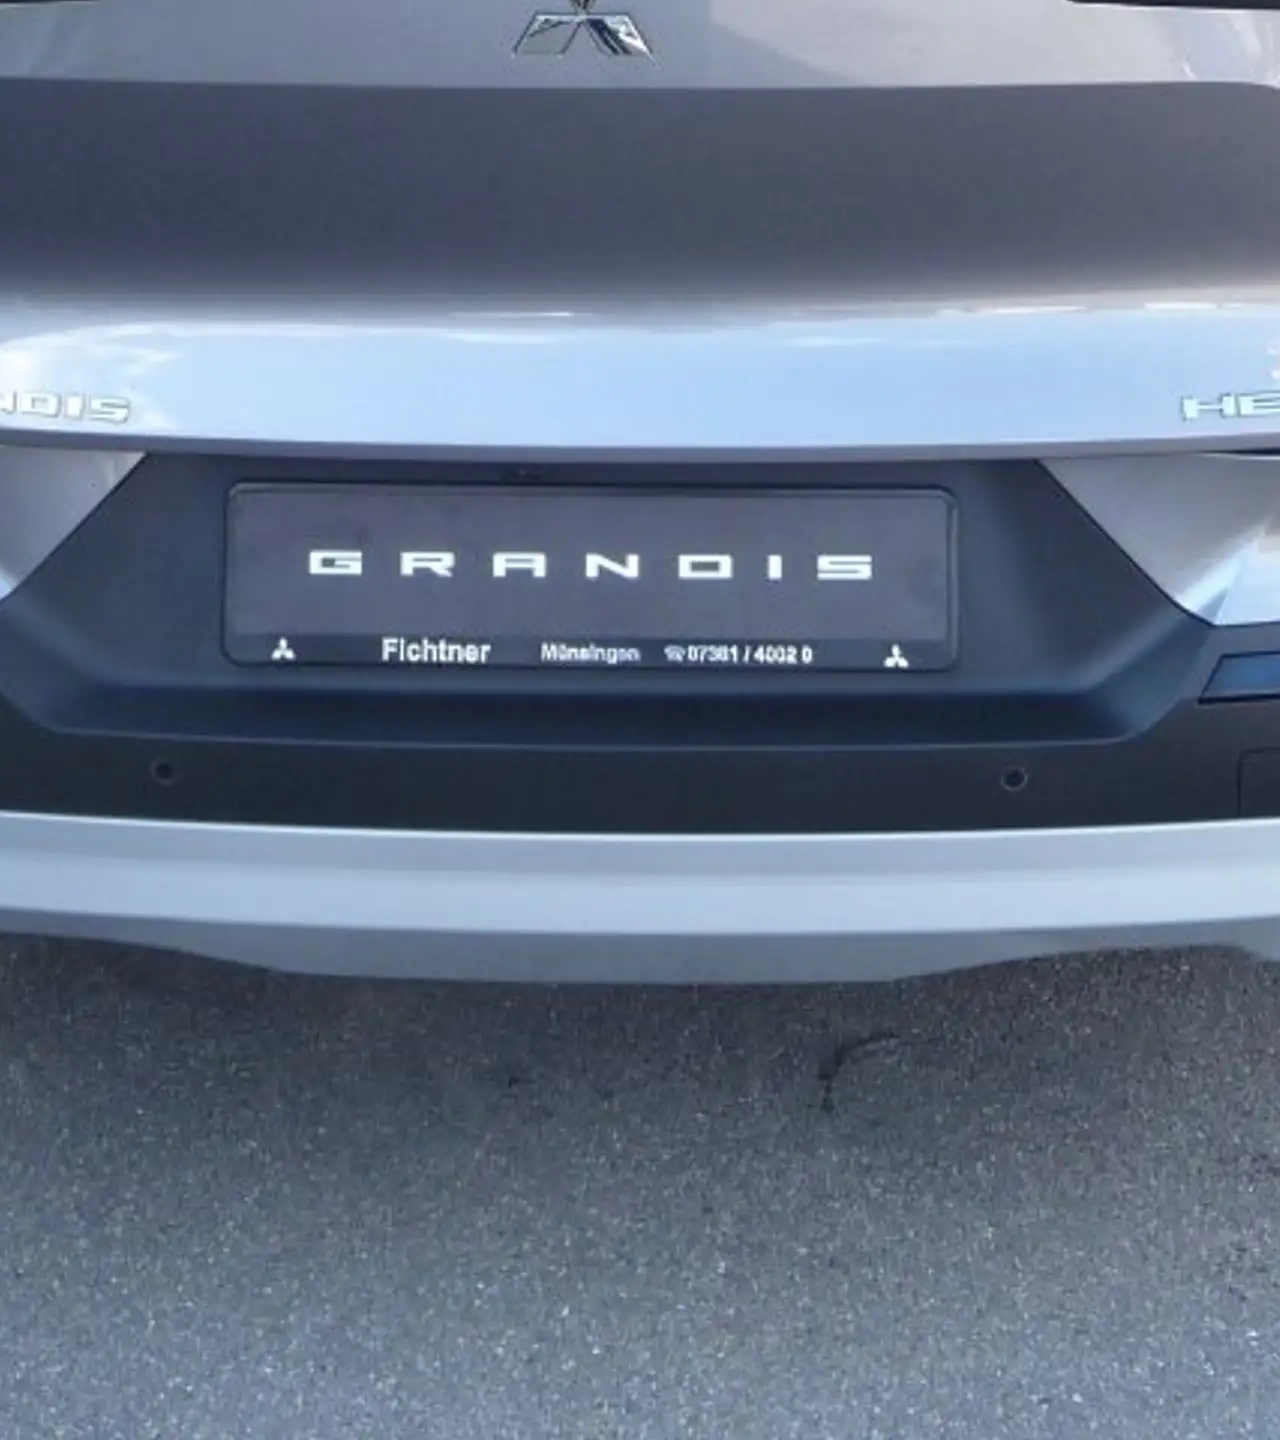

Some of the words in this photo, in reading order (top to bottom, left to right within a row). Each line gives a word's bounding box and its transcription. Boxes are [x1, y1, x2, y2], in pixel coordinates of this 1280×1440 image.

[309, 550, 873, 581] GRANDIS
[381, 637, 491, 665] Fichtner
[540, 642, 641, 665] Münsingen
